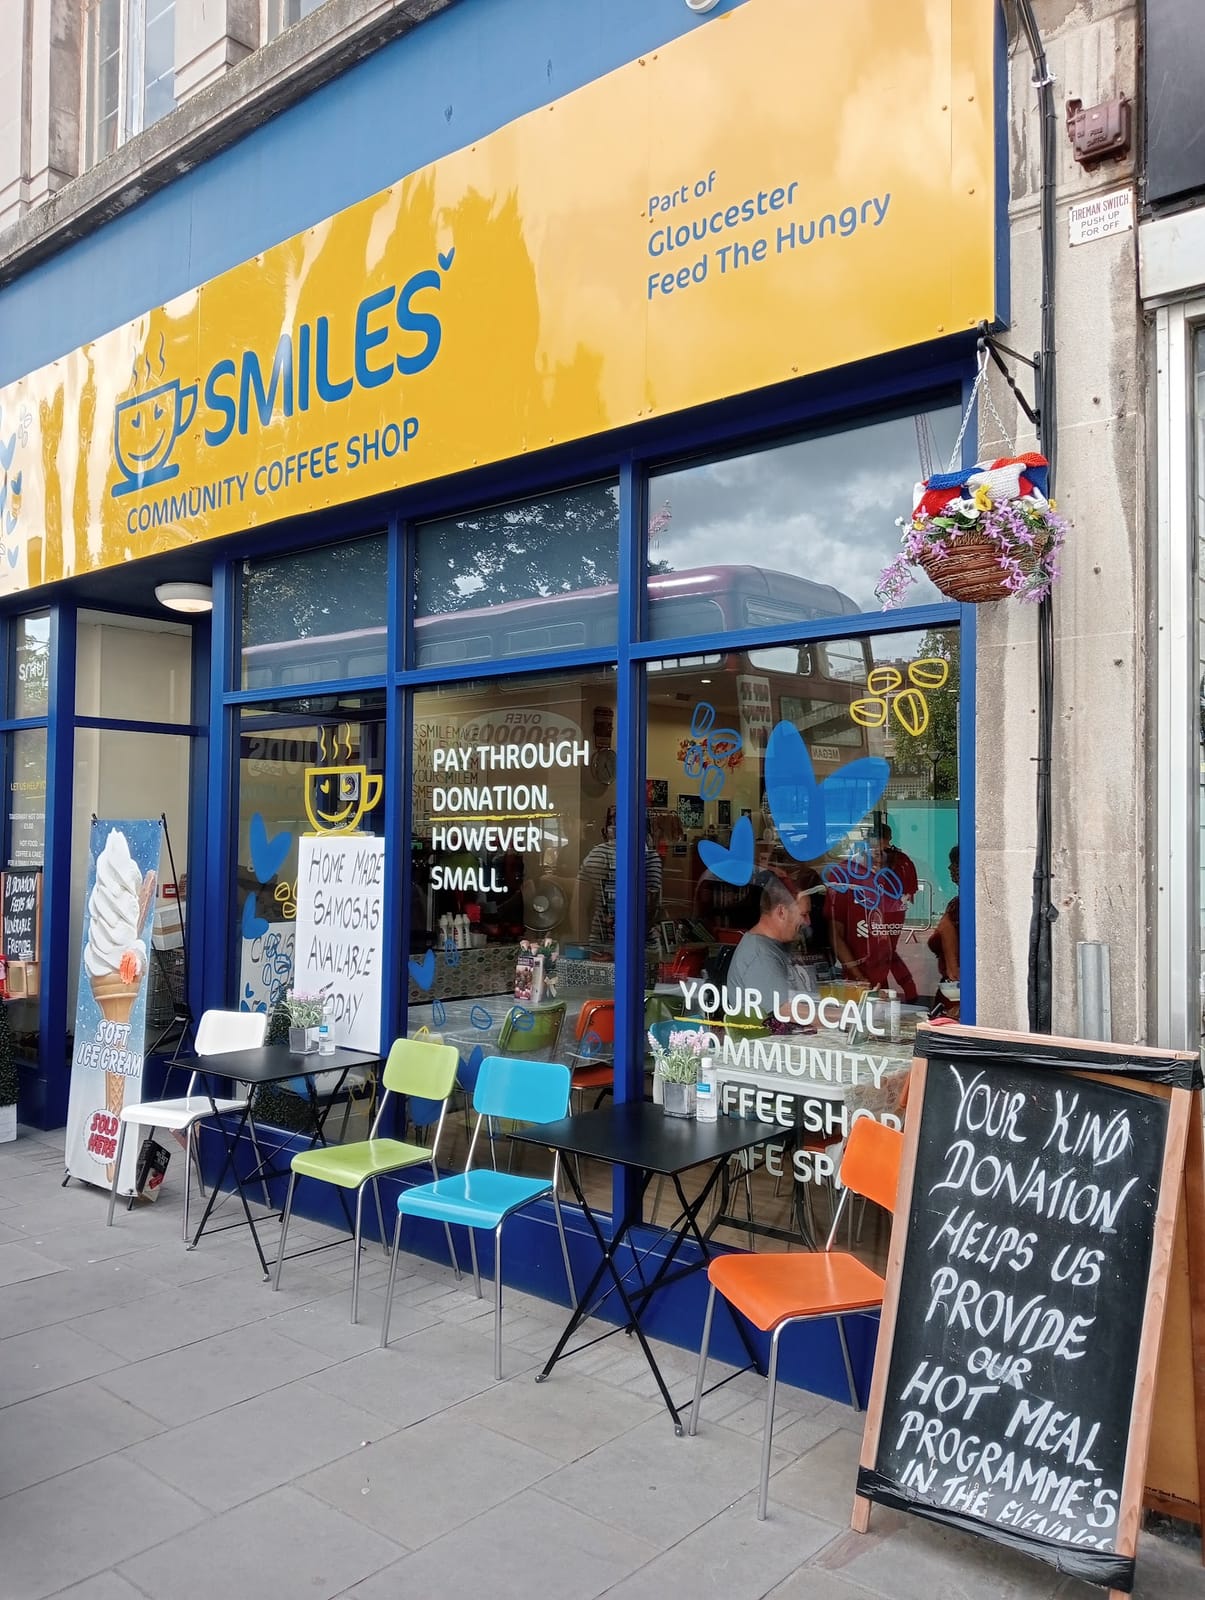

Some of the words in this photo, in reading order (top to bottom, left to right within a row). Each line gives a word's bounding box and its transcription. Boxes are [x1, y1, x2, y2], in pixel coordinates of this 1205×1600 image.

[648, 184, 689, 218] Part
[693, 170, 717, 200] of
[1071, 203, 1101, 222] FIREMAN
[1103, 193, 1129, 212] SWITCH
[648, 181, 799, 258] Gloucester
[1080, 215, 1105, 229] PUSH
[1108, 210, 1120, 221] UP
[1081, 227, 1099, 238] FOR
[1103, 220, 1120, 232] OFF
[647, 252, 709, 300] Feed
[716, 240, 768, 276] The
[775, 192, 891, 255] Hungry
[204, 269, 443, 447] SMILES
[127, 472, 249, 535] COMMUNITY
[253, 441, 339, 496] COFFEE
[346, 417, 420, 470] SHOP
[433, 747, 471, 773] PAY
[476, 740, 590, 771] THROUGH
[432, 785, 554, 812] DONATION.
[431, 826, 541, 853] HOWEVER
[309, 848, 346, 884] HOME
[351, 849, 385, 887] MADE
[430, 866, 509, 894] SMALL.
[313, 890, 380, 931] SAMOSAS
[307, 935, 376, 980] AVAILABLE
[679, 980, 764, 1020] YOUR
[773, 991, 886, 1036] LOCAL
[96, 1019, 131, 1050] SOFT
[76, 1042, 101, 1069] ICE
[100, 1047, 144, 1078] CREAM
[684, 1029, 889, 1089] OMMUNITY
[90, 1112, 120, 1137] SOLD
[722, 1085, 795, 1127] FFEE
[949, 1063, 1027, 1143] YOUR
[1042, 1088, 1135, 1167] KIND
[87, 1133, 118, 1159] HERE
[927, 1139, 1140, 1235] DONATION
[927, 1205, 1038, 1272] HELPS
[1050, 1243, 1106, 1286] US
[924, 1266, 1097, 1361] PROVIDE
[967, 1346, 1033, 1391] OUR
[900, 1361, 1000, 1421] HOT
[1004, 1399, 1104, 1472] MEAL
[895, 1410, 1119, 1529] PROGRAMME'S
[900, 1459, 938, 1494] IN
[940, 1475, 992, 1517] THE
